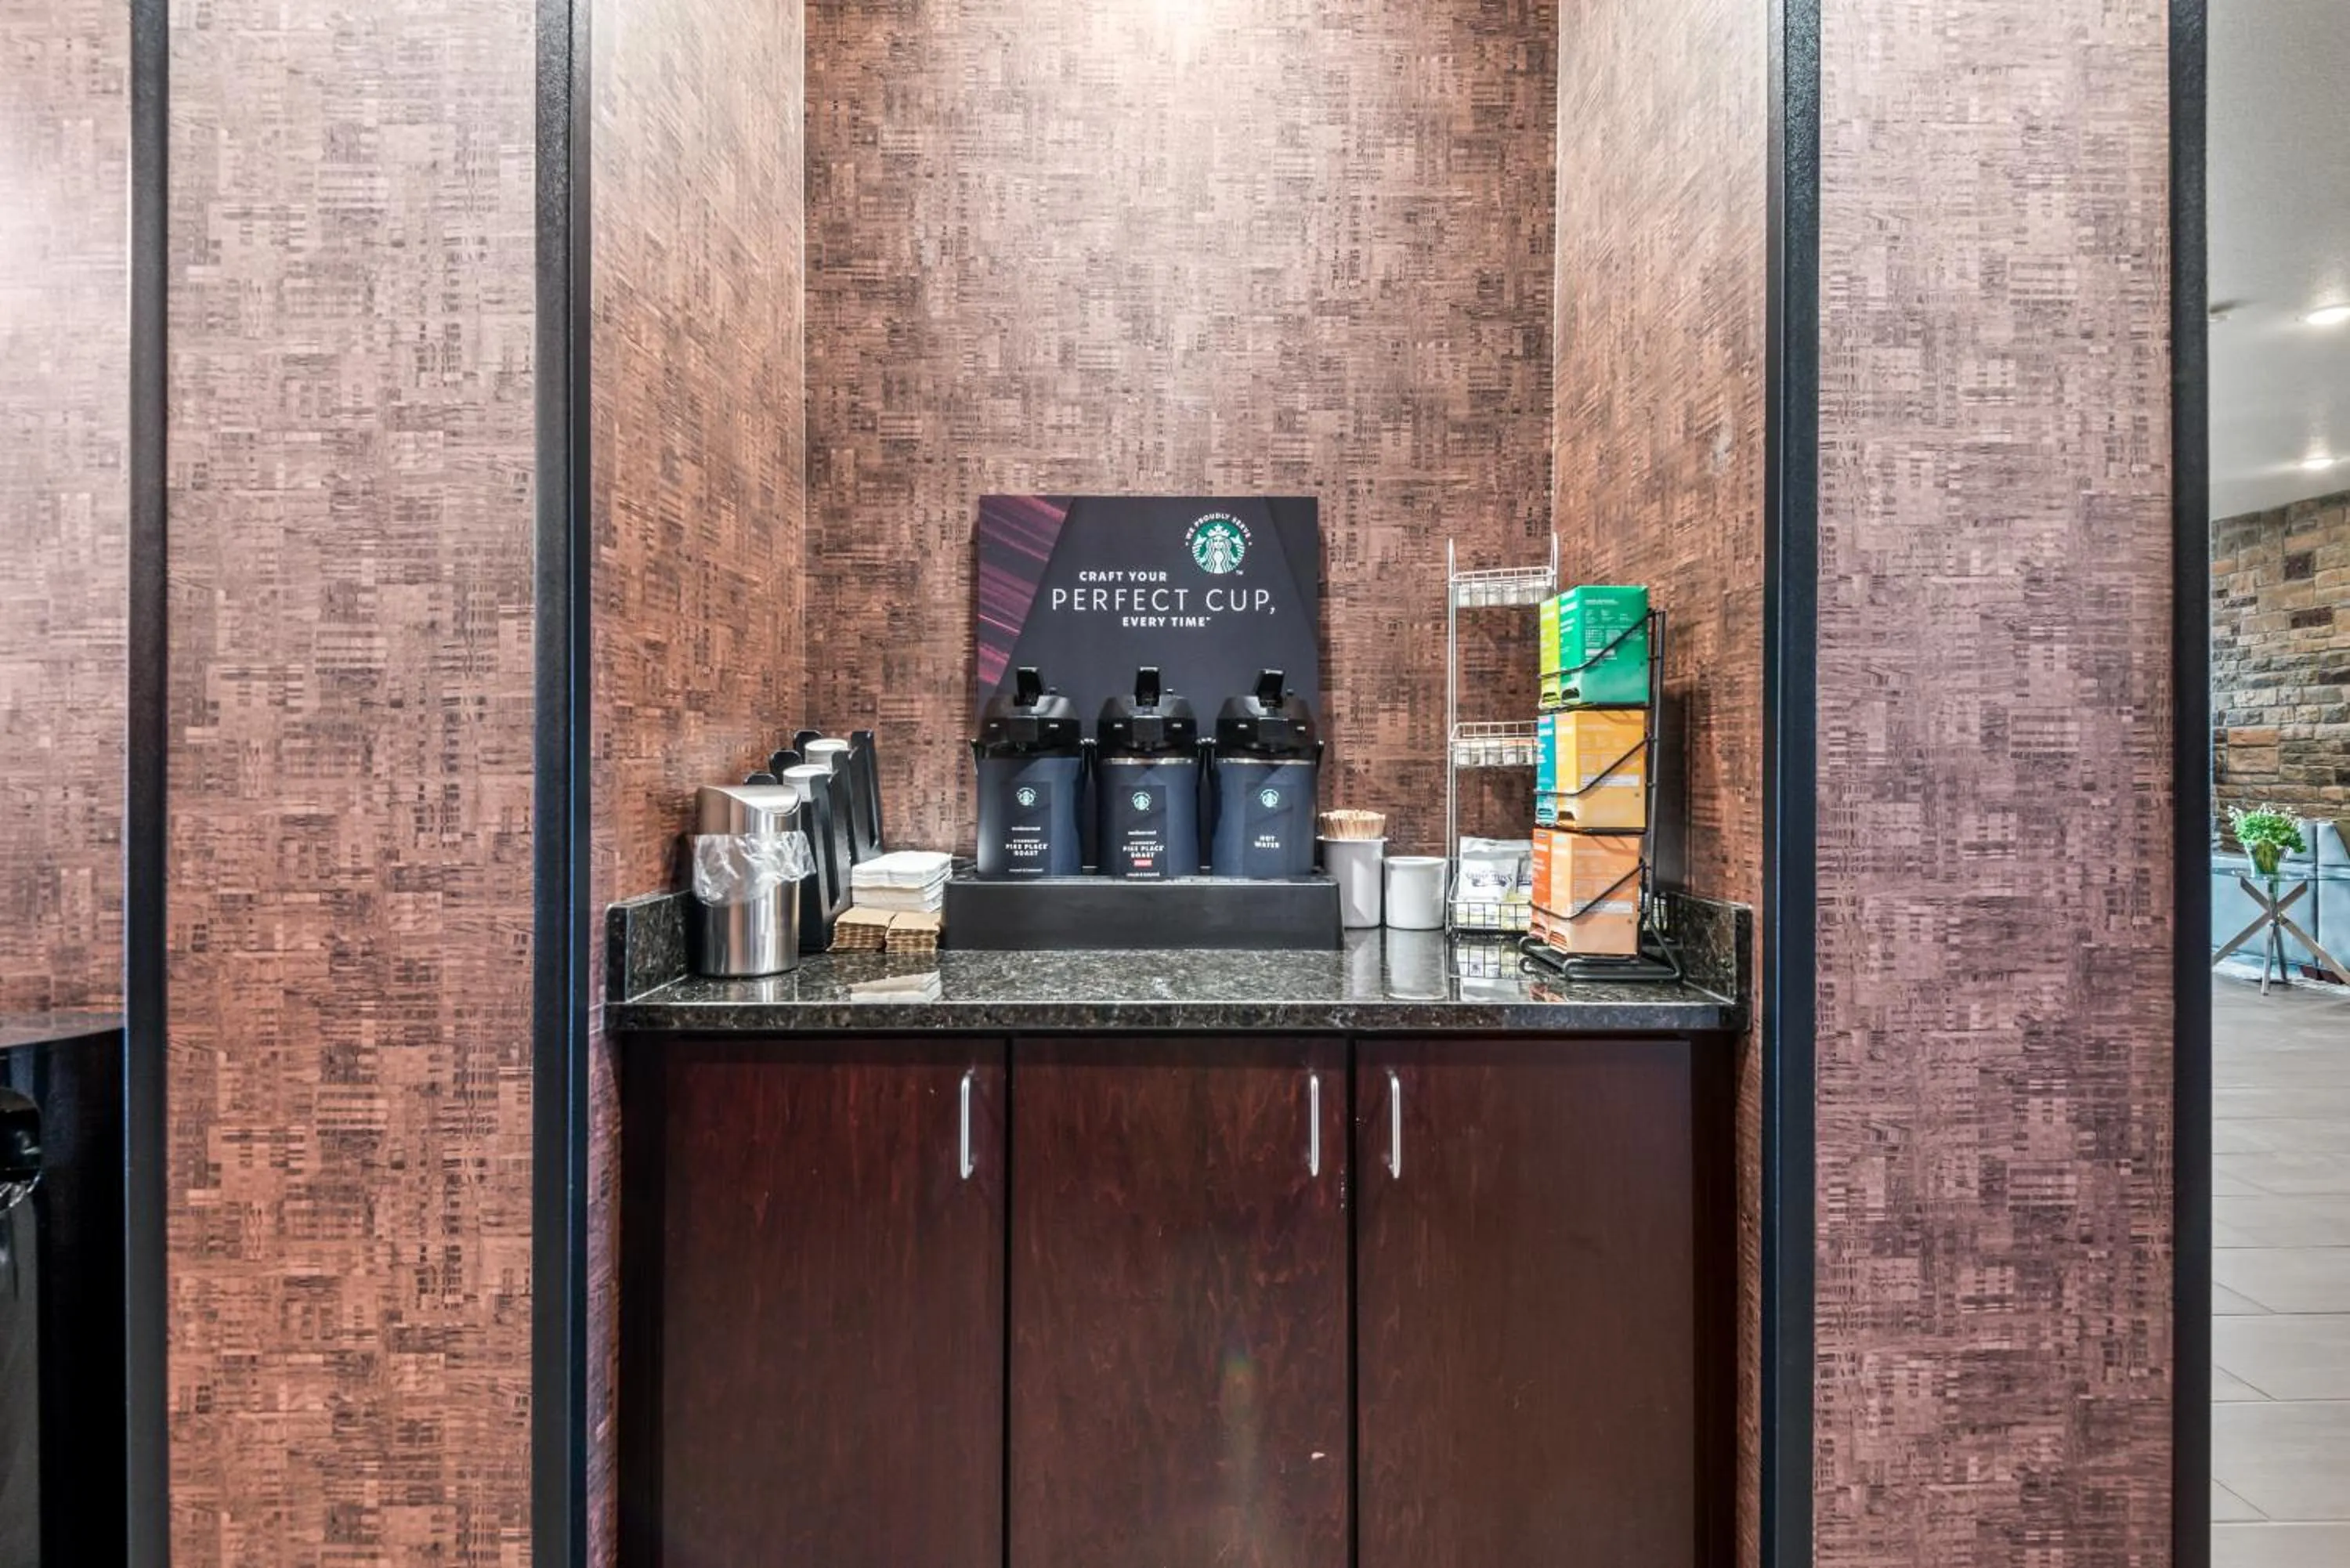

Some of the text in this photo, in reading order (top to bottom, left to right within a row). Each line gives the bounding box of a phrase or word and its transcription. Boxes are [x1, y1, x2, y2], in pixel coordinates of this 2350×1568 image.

[1185, 512, 1251, 540] WE PROUDLY SERVE
[1079, 570, 1167, 582] CRAFT YOUR
[1051, 587, 1276, 615] PERFECT CUP,
[1122, 616, 1166, 627] EVERY
